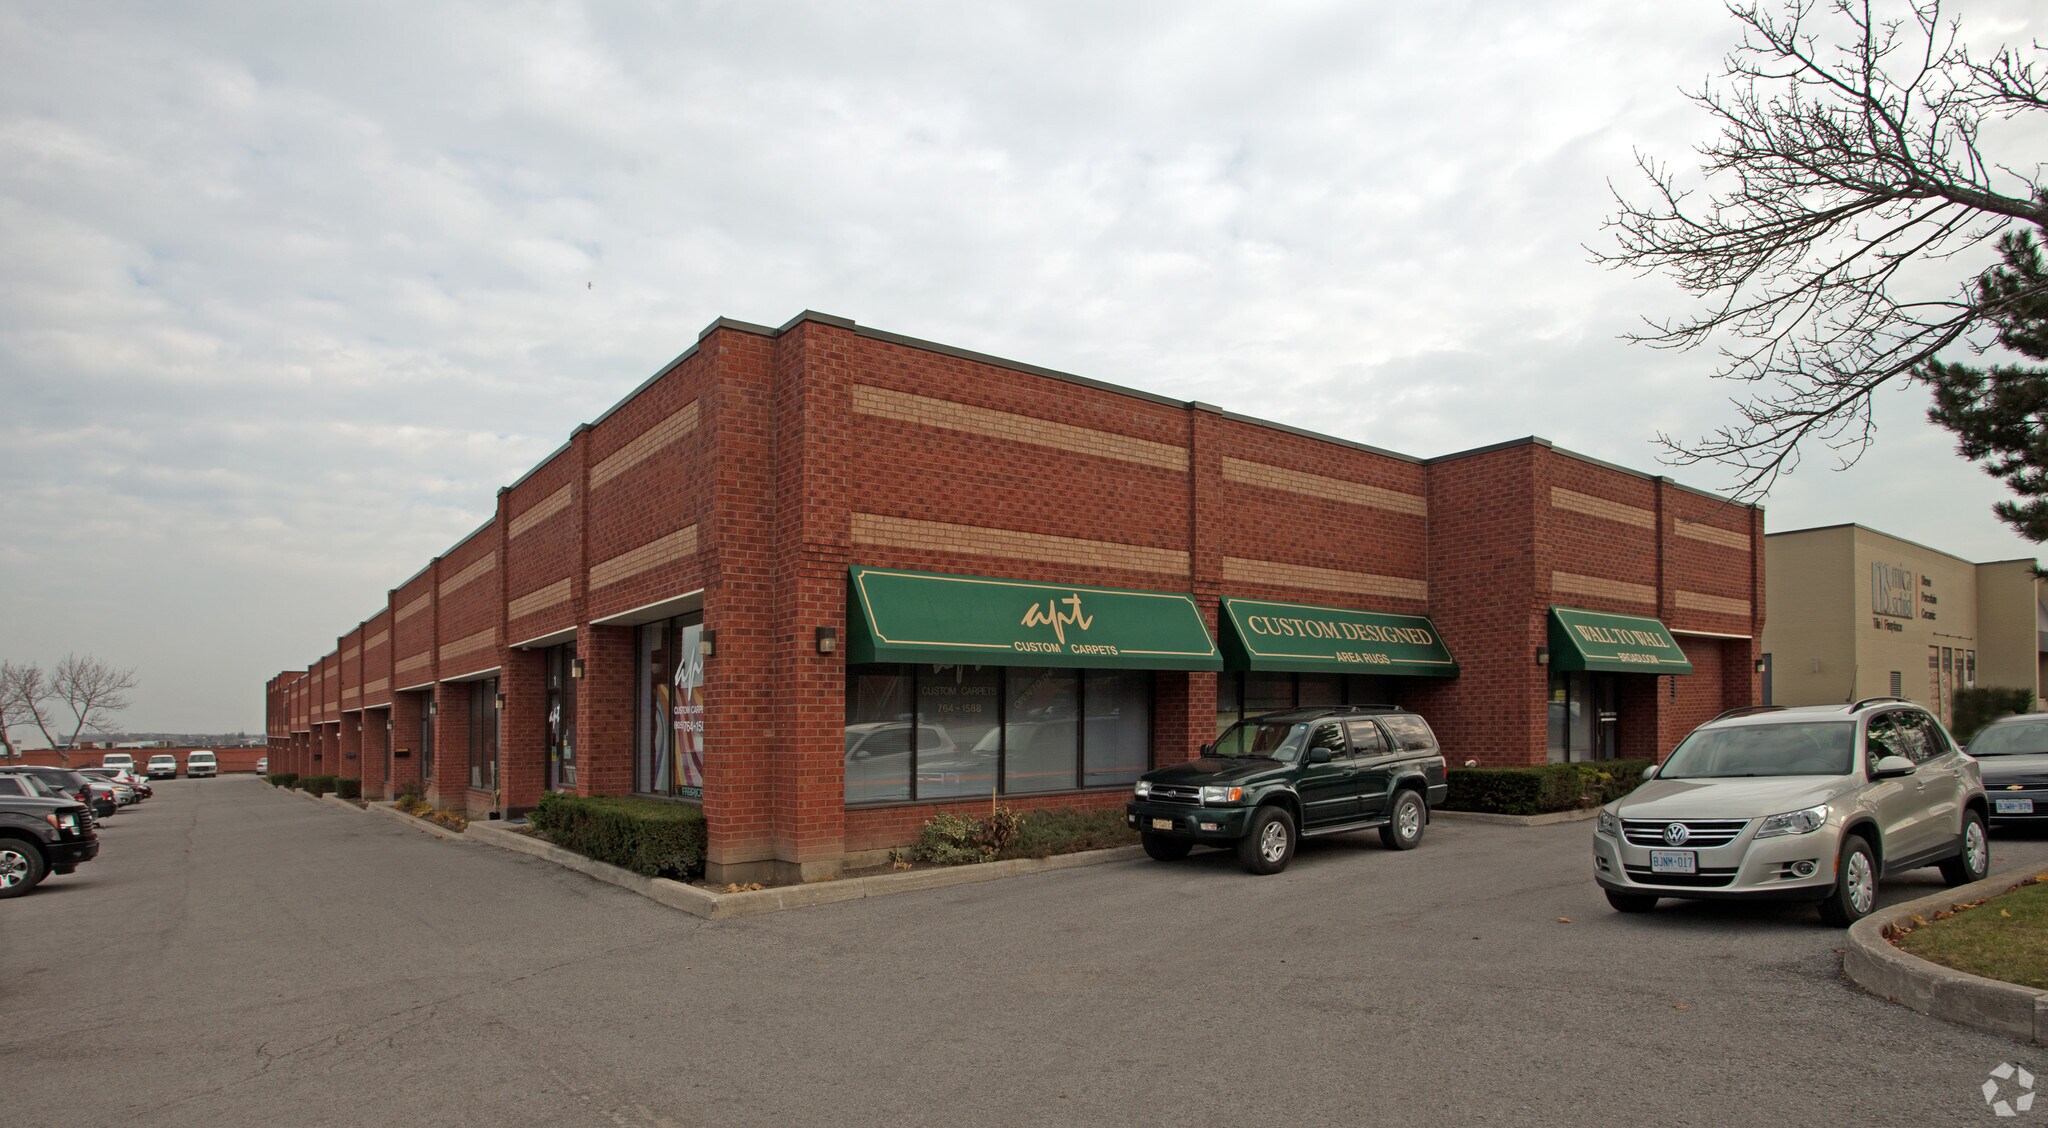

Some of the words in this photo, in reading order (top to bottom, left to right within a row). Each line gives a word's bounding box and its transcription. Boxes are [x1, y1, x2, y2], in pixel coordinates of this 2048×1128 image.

[1021, 593, 1093, 645] apt
[1248, 615, 1343, 640] CUSTOM
[1339, 622, 1432, 645] DESIGNED
[1575, 624, 1618, 644] WALL
[1611, 627, 1636, 646] TO
[1630, 630, 1671, 649] WALL
[1014, 641, 1062, 653] CUSTOM
[1071, 643, 1119, 656] CARPETS
[1336, 651, 1363, 664] AREA
[1364, 652, 1391, 665] RUGS
[675, 646, 703, 701] ap
[921, 686, 957, 695] CUSTOM
[961, 686, 997, 696] CARPETS
[1014, 687, 1033, 709] OPEN
[674, 706, 690, 715] CUSTOM
